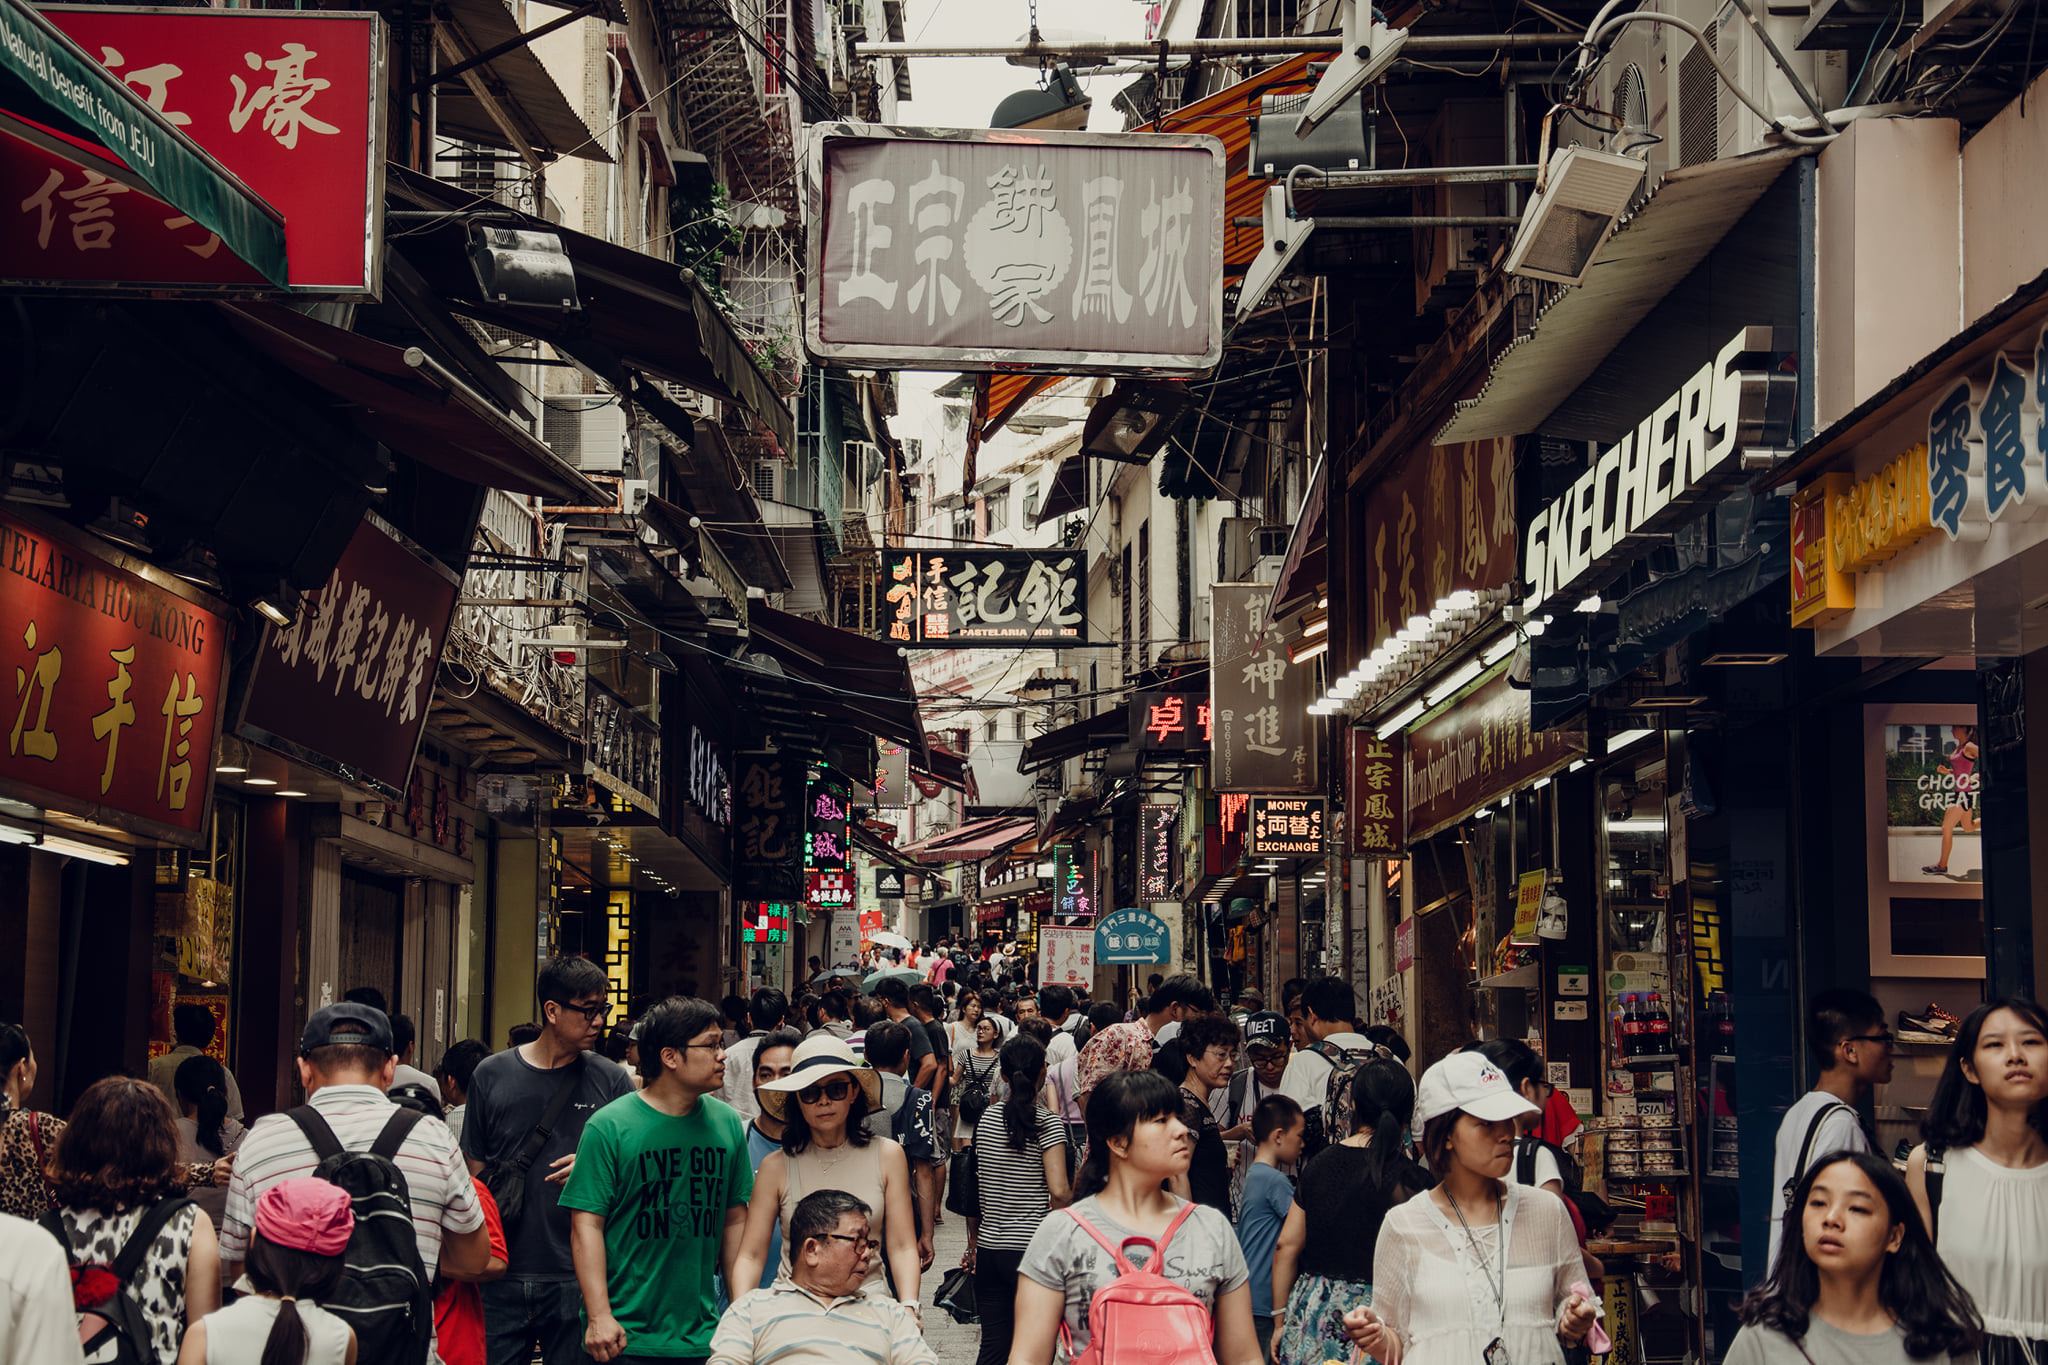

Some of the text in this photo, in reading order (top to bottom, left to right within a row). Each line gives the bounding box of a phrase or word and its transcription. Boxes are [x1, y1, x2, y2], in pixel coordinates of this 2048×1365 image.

[3, 21, 155, 168] Natural benefit from JEJU
[1523, 326, 1747, 616] SKECHERS
[922, 557, 948, 611] 手信
[100, 576, 148, 630] HOU
[148, 596, 206, 656] KONG
[960, 628, 1028, 637] PASTELARIA
[1060, 628, 1078, 637] KEI
[1457, 730, 1477, 786] Store
[1267, 801, 1308, 811] MONEY
[1361, 735, 1396, 852] 正宗鳳城
[1919, 791, 1980, 811] GREAT
[1257, 841, 1319, 852] EXCHANGE
[639, 1146, 727, 1182] I'VE GOT
[641, 1177, 724, 1209] MY EYE
[638, 1210, 670, 1240] ON
